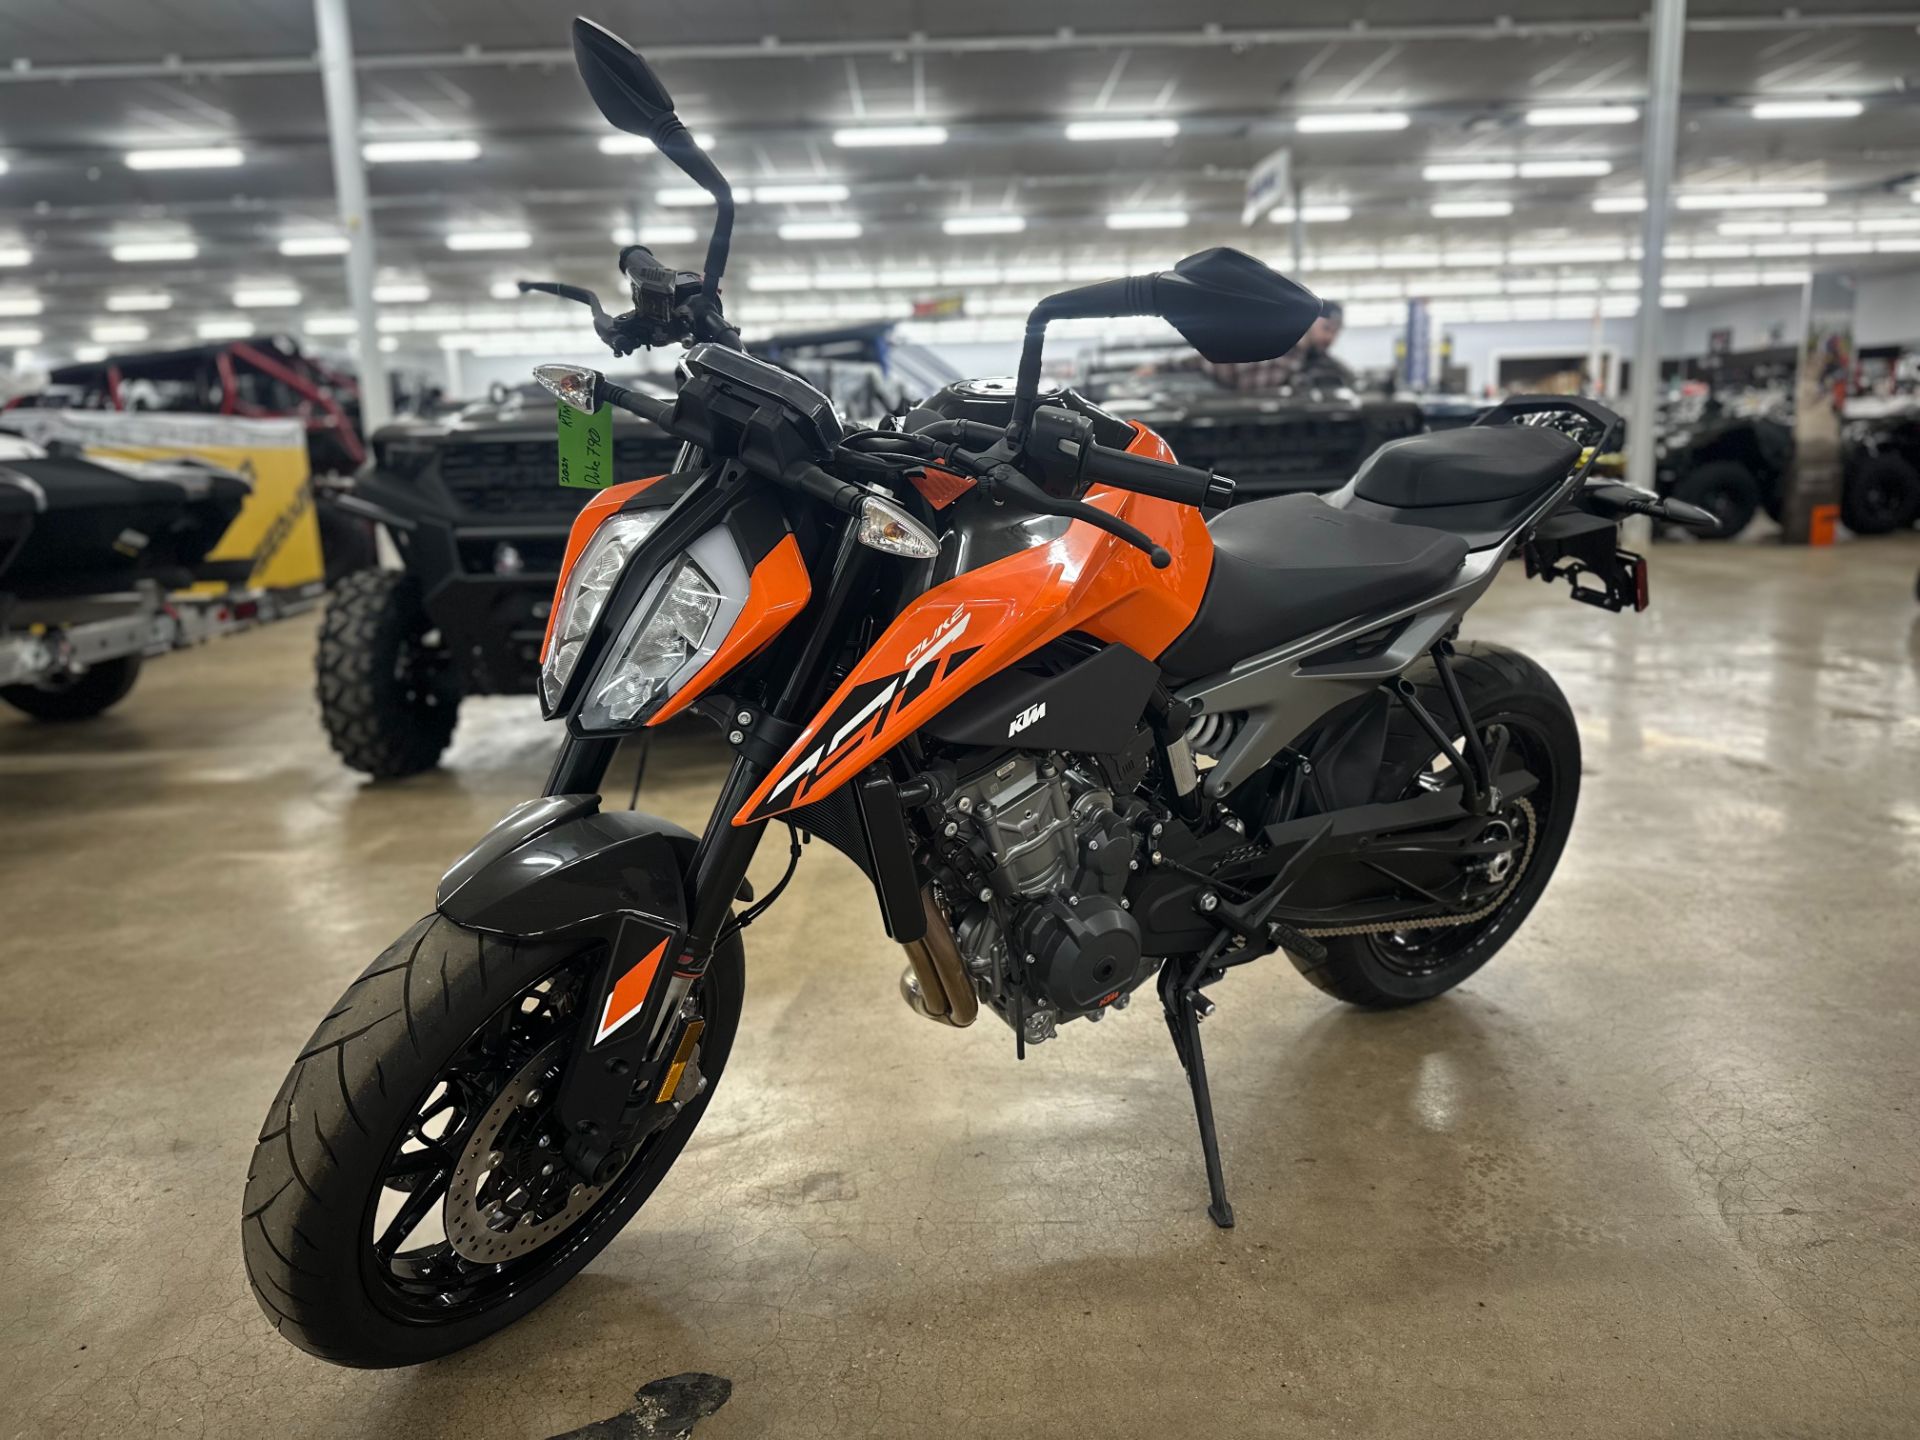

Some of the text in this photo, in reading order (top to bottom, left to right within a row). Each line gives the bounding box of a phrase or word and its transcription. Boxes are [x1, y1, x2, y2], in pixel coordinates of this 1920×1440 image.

[558, 405, 573, 428] KTM
[584, 427, 601, 485] Duke 790
[905, 602, 964, 667] DUKE
[1008, 702, 1046, 738] KTM
